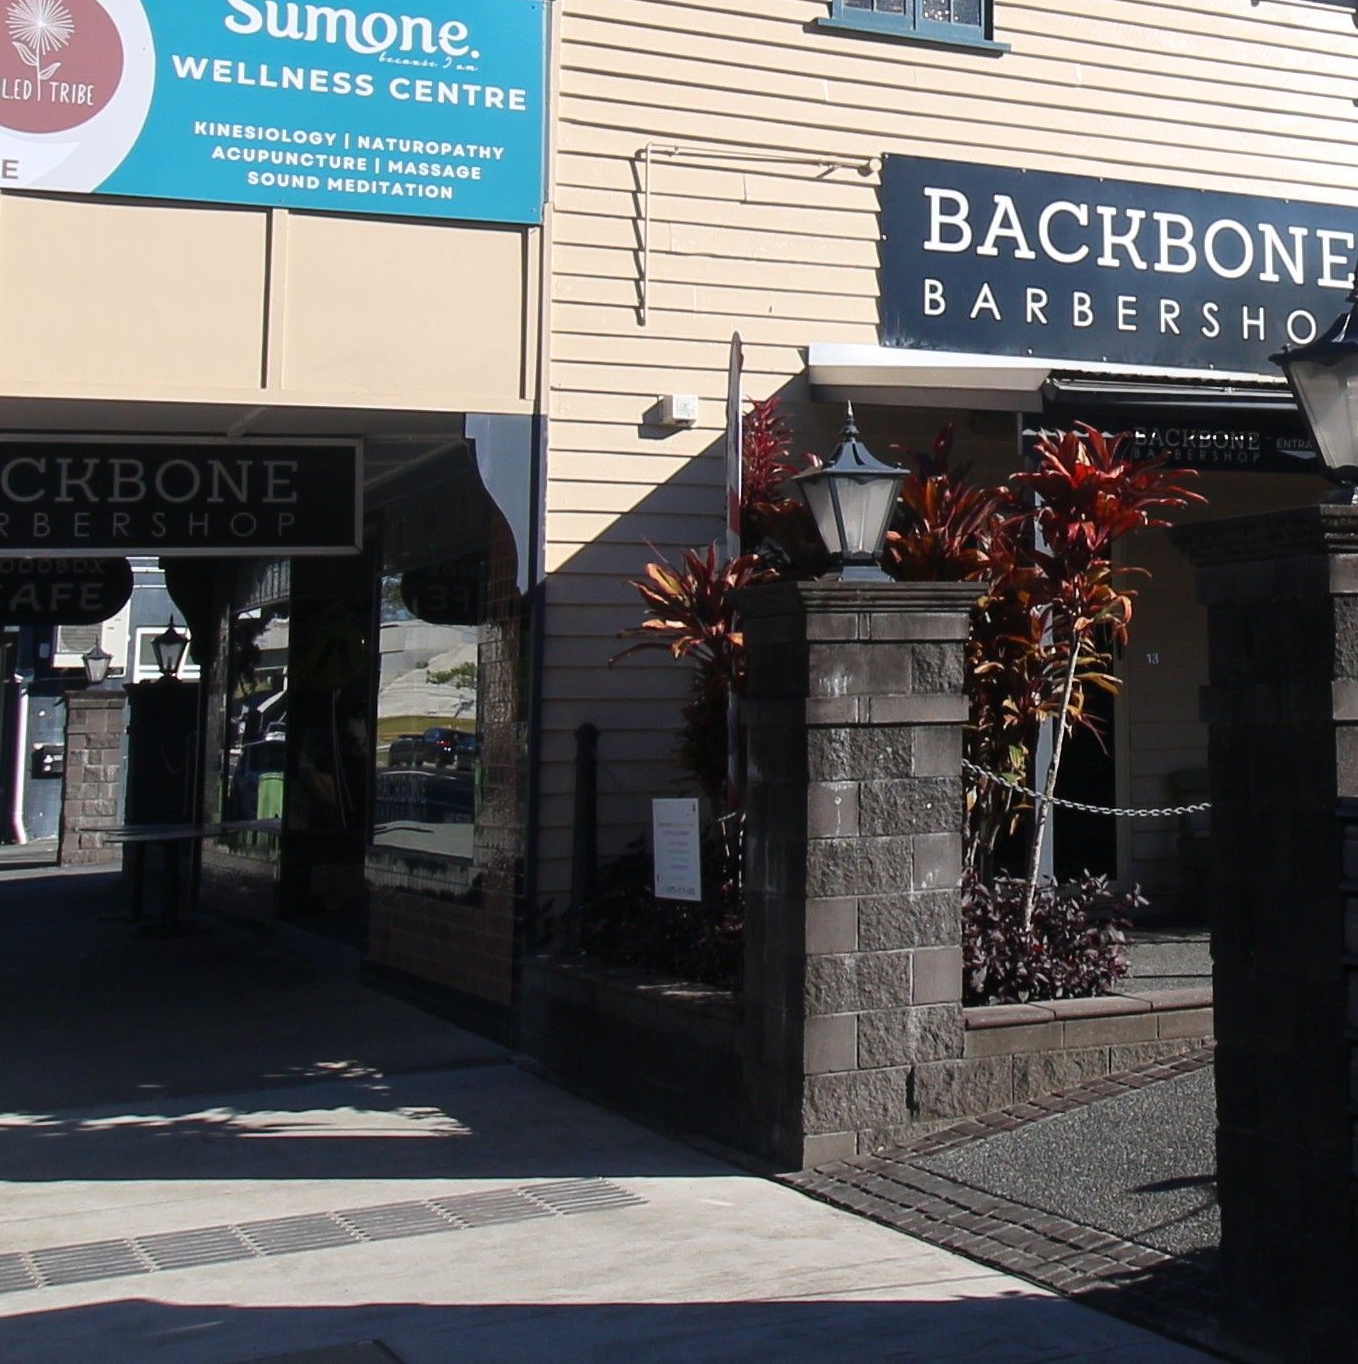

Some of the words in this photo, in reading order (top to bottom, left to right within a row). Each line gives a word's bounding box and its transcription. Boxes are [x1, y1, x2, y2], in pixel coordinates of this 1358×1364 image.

[378, 51, 438, 68] because
[49, 81, 95, 106] TRIBE
[172, 54, 374, 97] WELLNESS
[389, 77, 527, 111] CENTRE
[194, 121, 337, 146] KINESIOLOGY
[358, 136, 505, 160] NATUROPATHY
[211, 145, 367, 171] ACUPUNCTURE
[388, 160, 482, 180] MASSAGE
[247, 171, 320, 190] SOUND
[327, 177, 453, 199] MEDITATION
[923, 187, 1356, 290] BACKBONE
[923, 278, 1317, 345] BARBERSHO
[1133, 426, 1261, 451] BACKBONE
[1276, 438, 1314, 449] ENTRA
